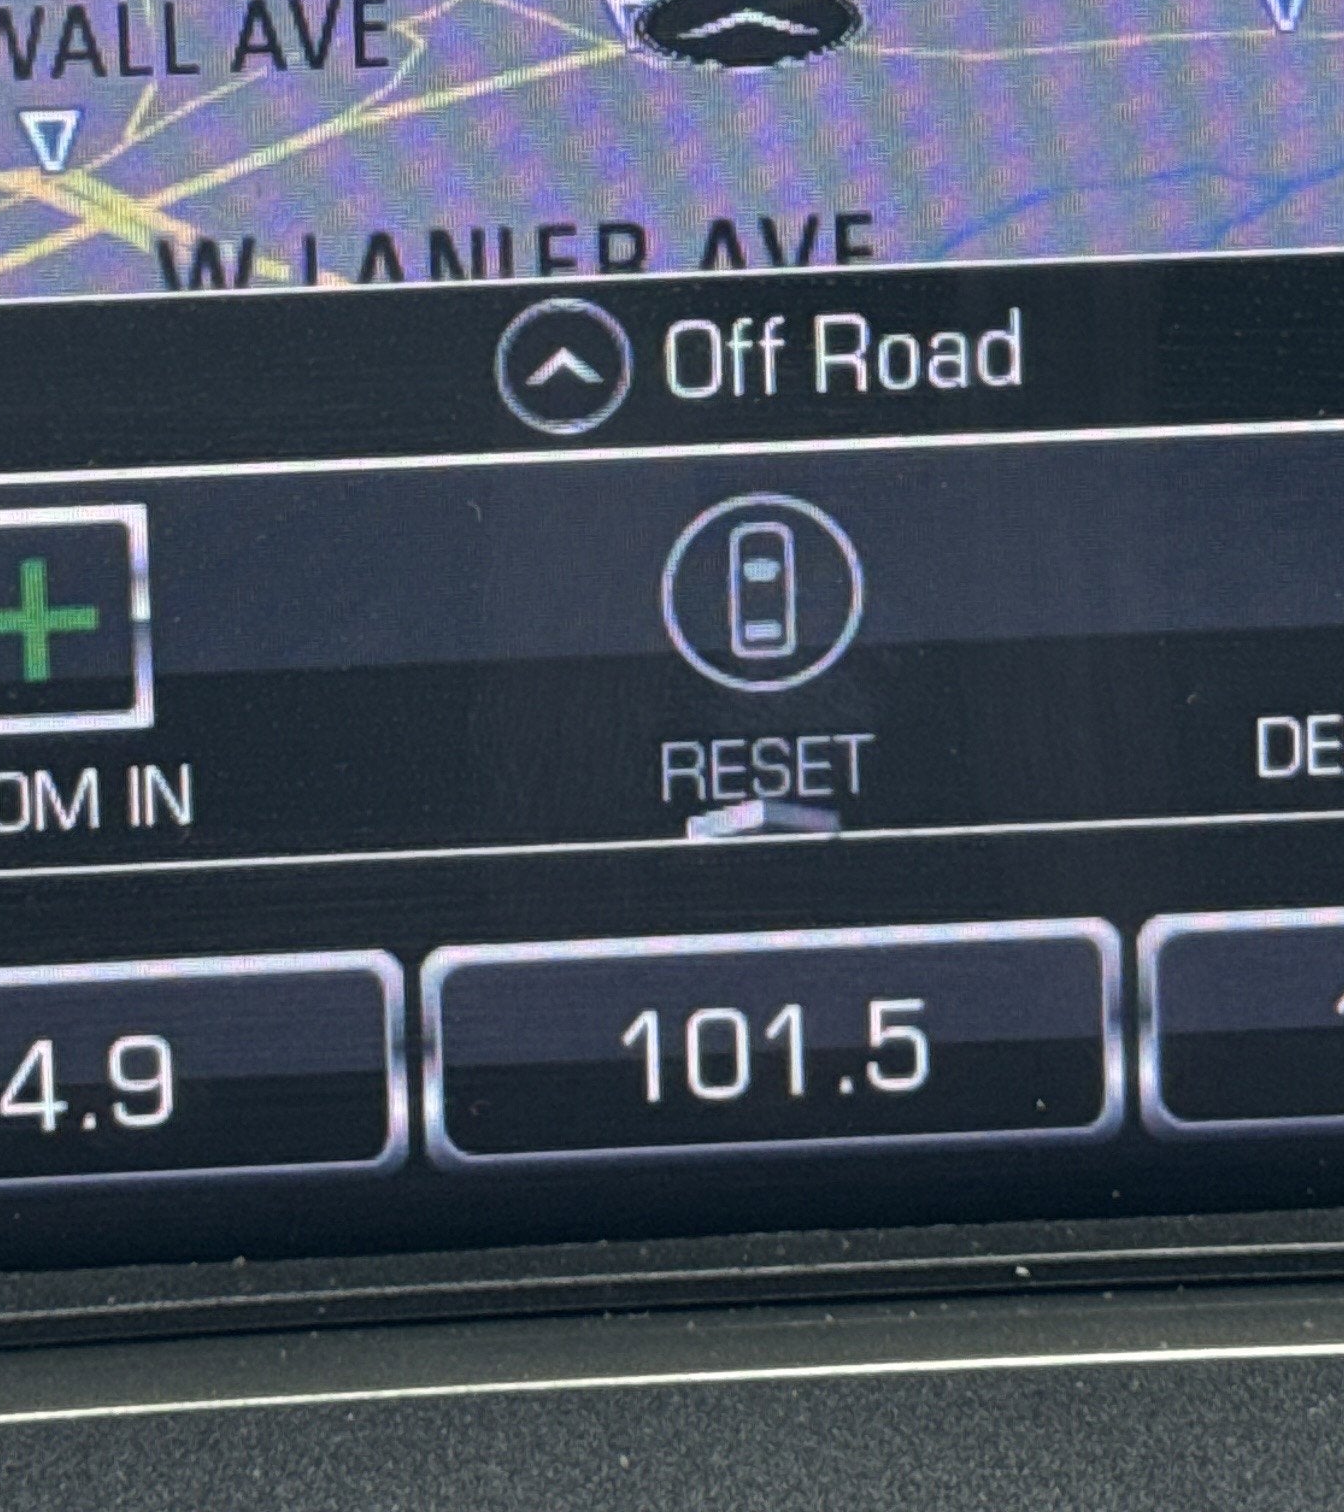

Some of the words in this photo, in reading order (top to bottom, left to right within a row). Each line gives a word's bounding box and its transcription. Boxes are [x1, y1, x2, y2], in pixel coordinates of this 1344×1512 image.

[663, 314, 786, 400] Off
[815, 307, 1024, 392] Road
[129, 763, 193, 830] IN
[660, 733, 875, 802] RESET
[620, 999, 931, 1105] 101.5
